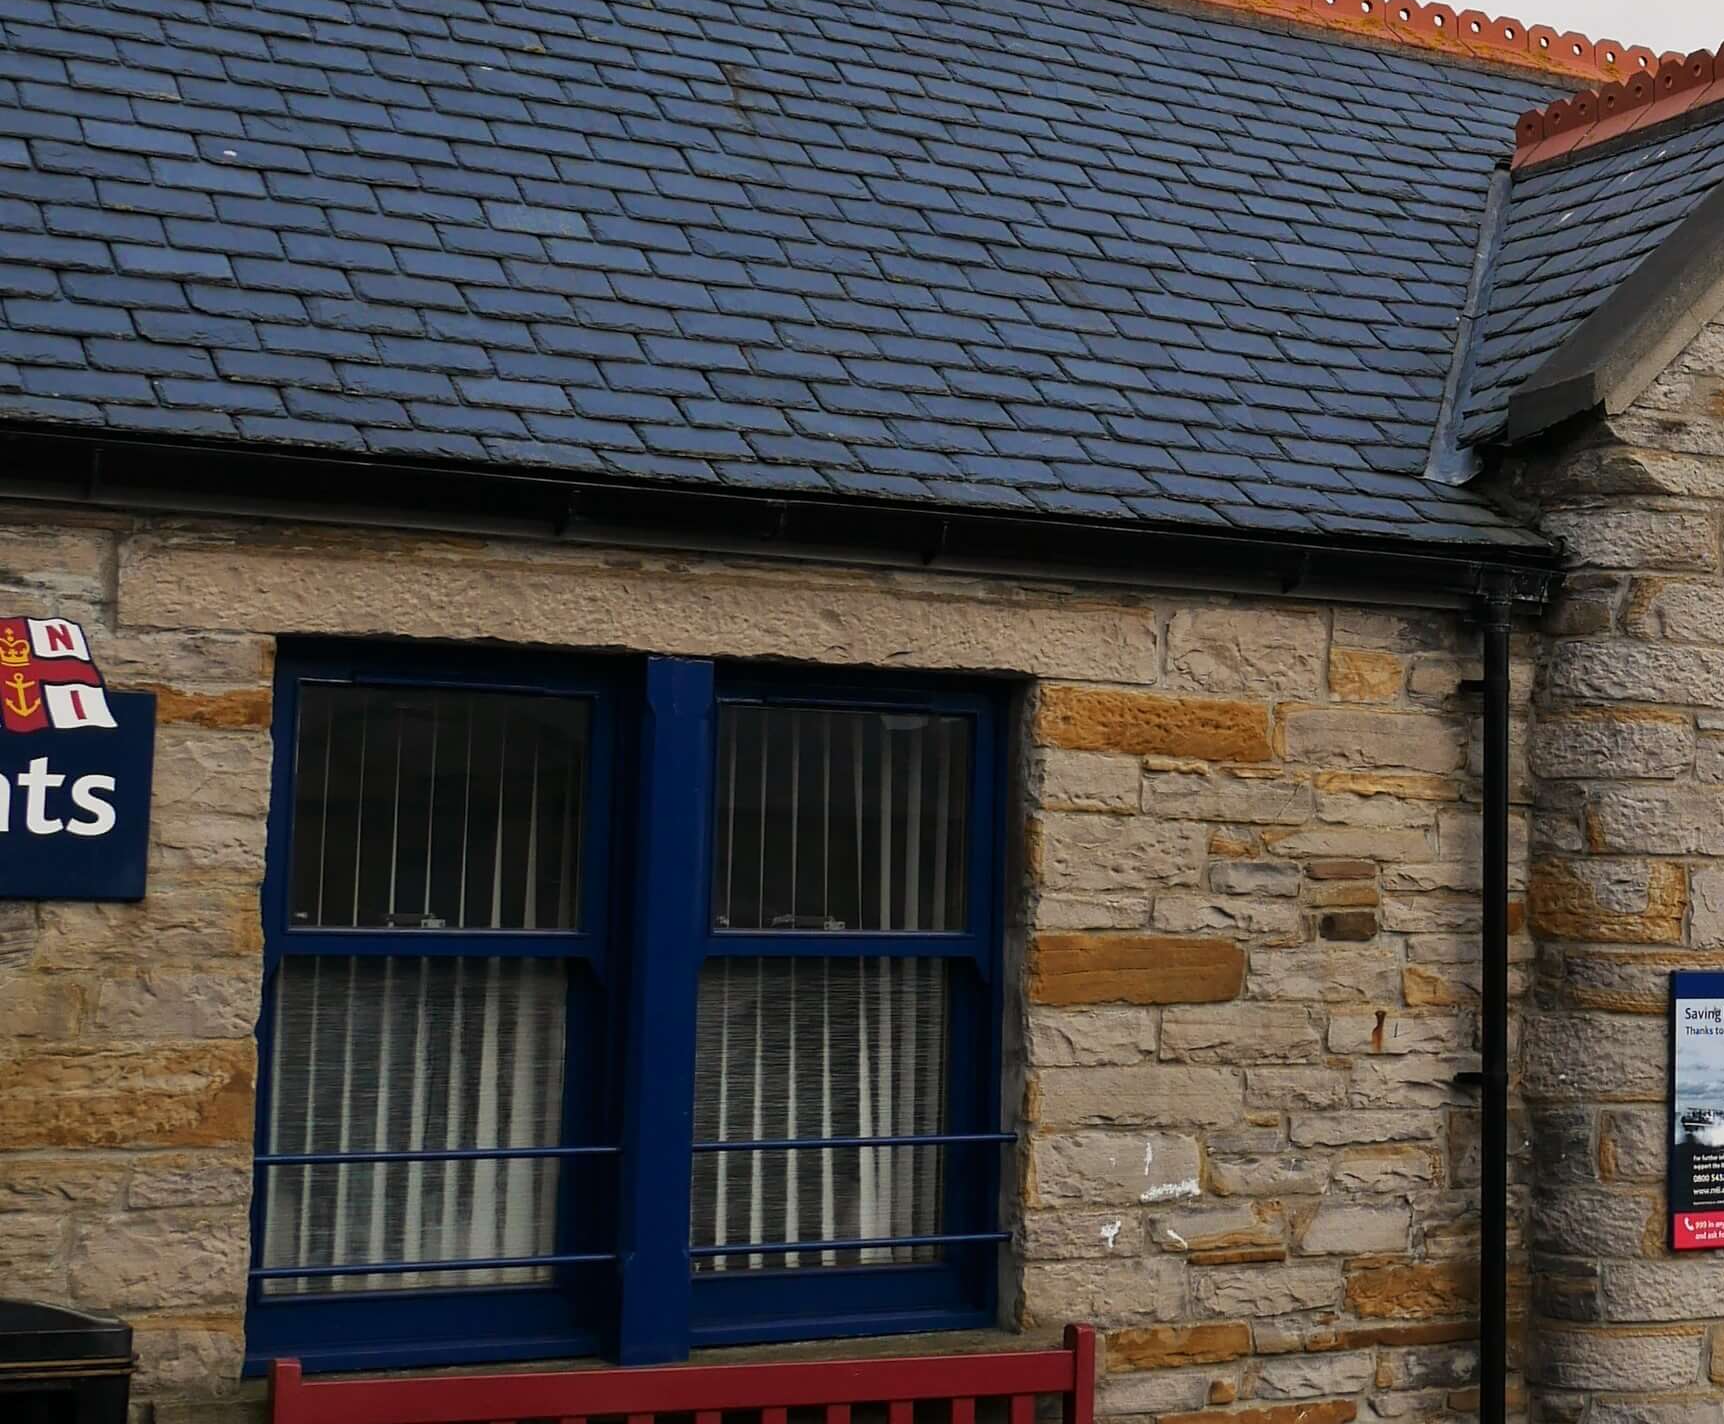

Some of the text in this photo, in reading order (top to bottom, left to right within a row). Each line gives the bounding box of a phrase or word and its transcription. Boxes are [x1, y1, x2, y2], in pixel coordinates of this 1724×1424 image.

[1685, 1007, 1721, 1023] Saving
[1686, 1026, 1713, 1035] Thanks
[1715, 1026, 1724, 1035] to
